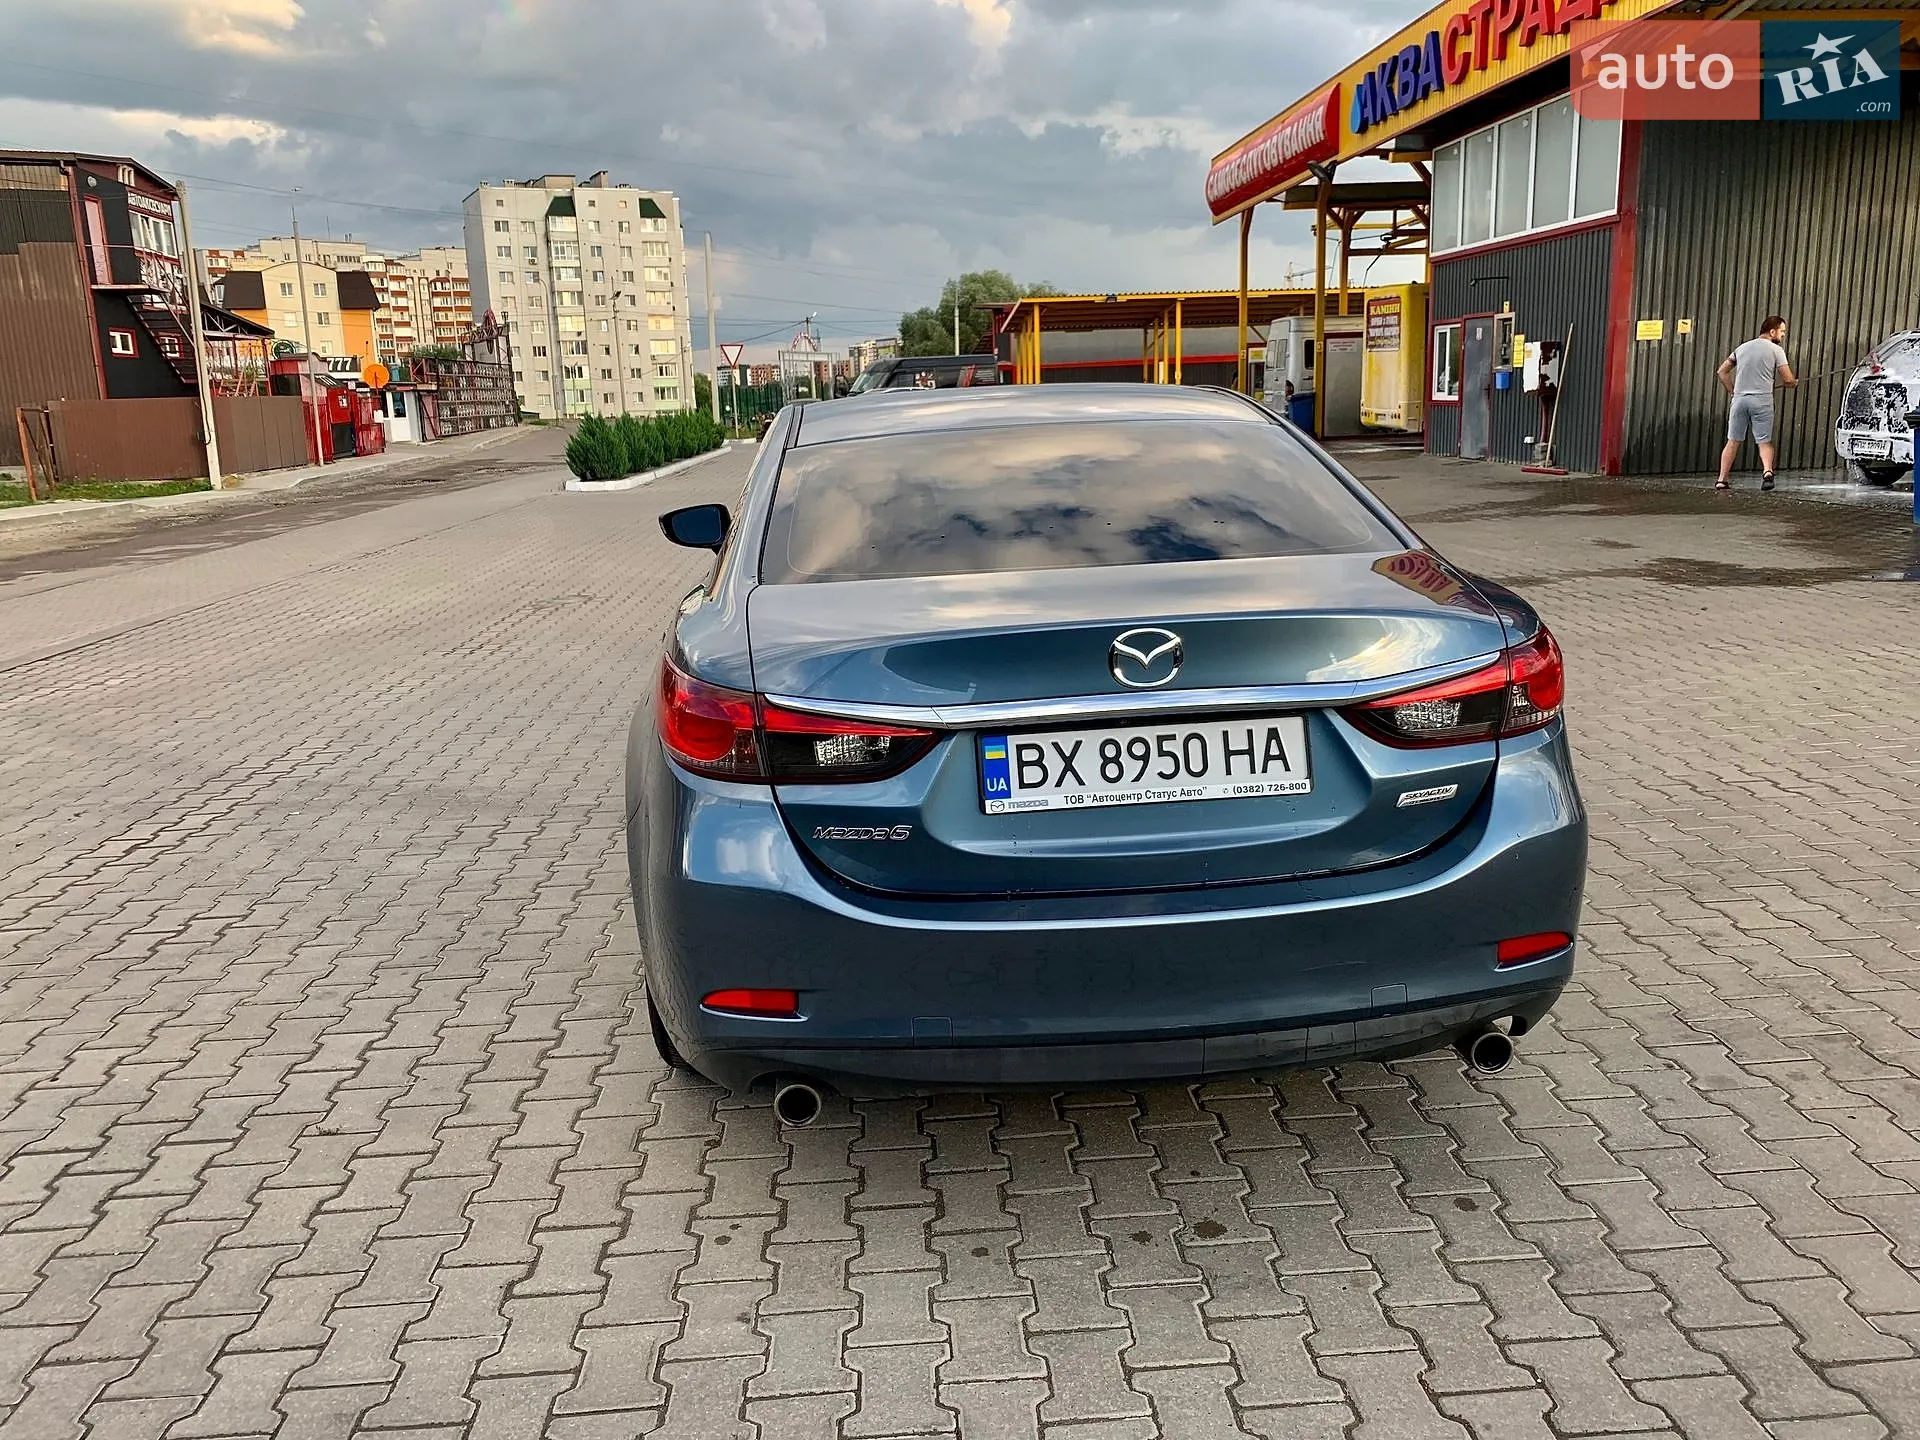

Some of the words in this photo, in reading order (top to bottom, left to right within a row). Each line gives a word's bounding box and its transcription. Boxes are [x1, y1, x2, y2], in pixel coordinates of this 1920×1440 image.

[326, 358, 352, 371] 777
[1015, 739, 1086, 790] BX
[1099, 732, 1208, 783] 8950
[1222, 726, 1292, 776] HA
[986, 778, 1008, 792] UA
[1063, 795, 1084, 805] ТОВ
[1145, 788, 1178, 801] Статус
[1232, 784, 1265, 795] (0382)
[1267, 781, 1307, 792] 726-800
[1404, 787, 1453, 800] SKYACTIV
